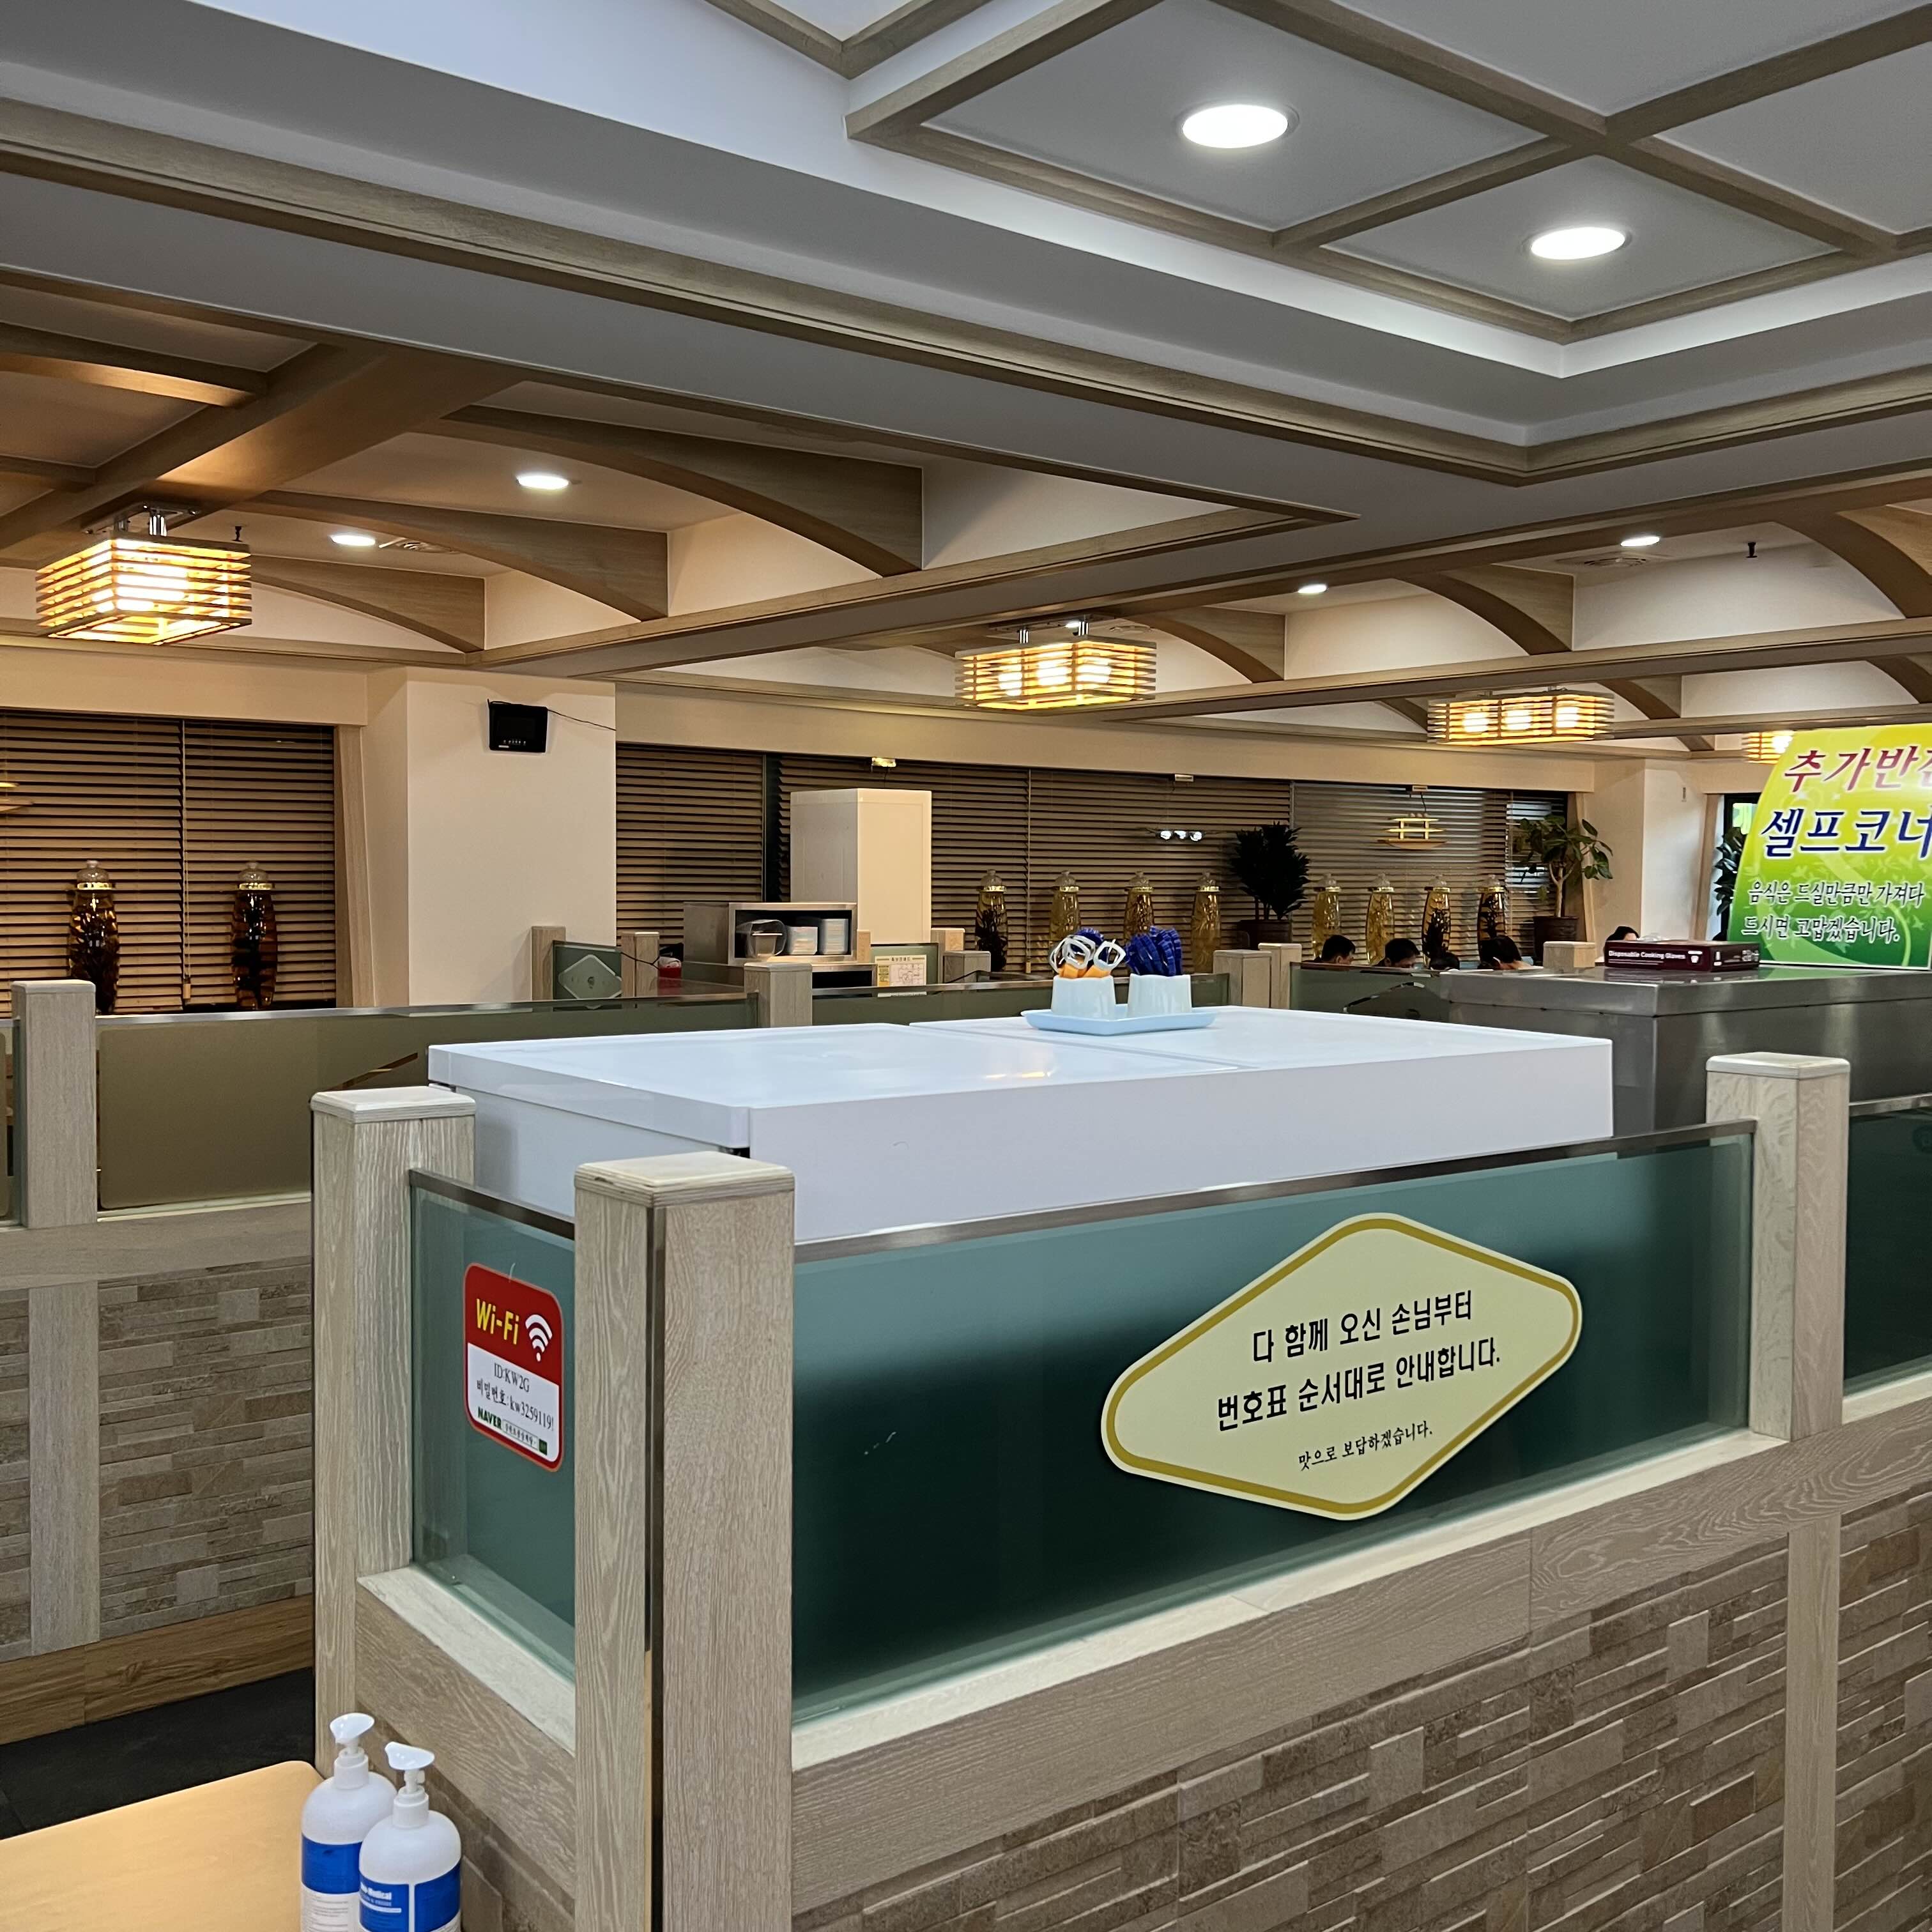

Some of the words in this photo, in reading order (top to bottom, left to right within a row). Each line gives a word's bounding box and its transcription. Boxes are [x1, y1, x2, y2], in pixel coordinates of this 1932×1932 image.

[1761, 806, 1932, 859] 셀프코너
[1749, 882, 1790, 904] 음식은
[1795, 882, 1872, 905] 드실만큼만
[1876, 882, 1924, 906] 가져다
[1743, 915, 1789, 939] 드시면
[1795, 916, 1900, 943] 고맙겠습니다.
[477, 1298, 519, 1346] Wi-Fi
[1252, 1329, 1274, 1363] 다
[1284, 1317, 1329, 1358] 함께
[1340, 1307, 1382, 1346] 오신
[1391, 1289, 1472, 1335] 손님부터
[1218, 1384, 1287, 1432] 번호표
[1298, 1363, 1386, 1414] 순서대로
[1396, 1337, 1501, 1389] 안내합니다.
[478, 1406, 502, 1430] NAVER
[1298, 1446, 1338, 1471] 맛으로
[1342, 1420, 1433, 1457] 보답하겠습니다.
